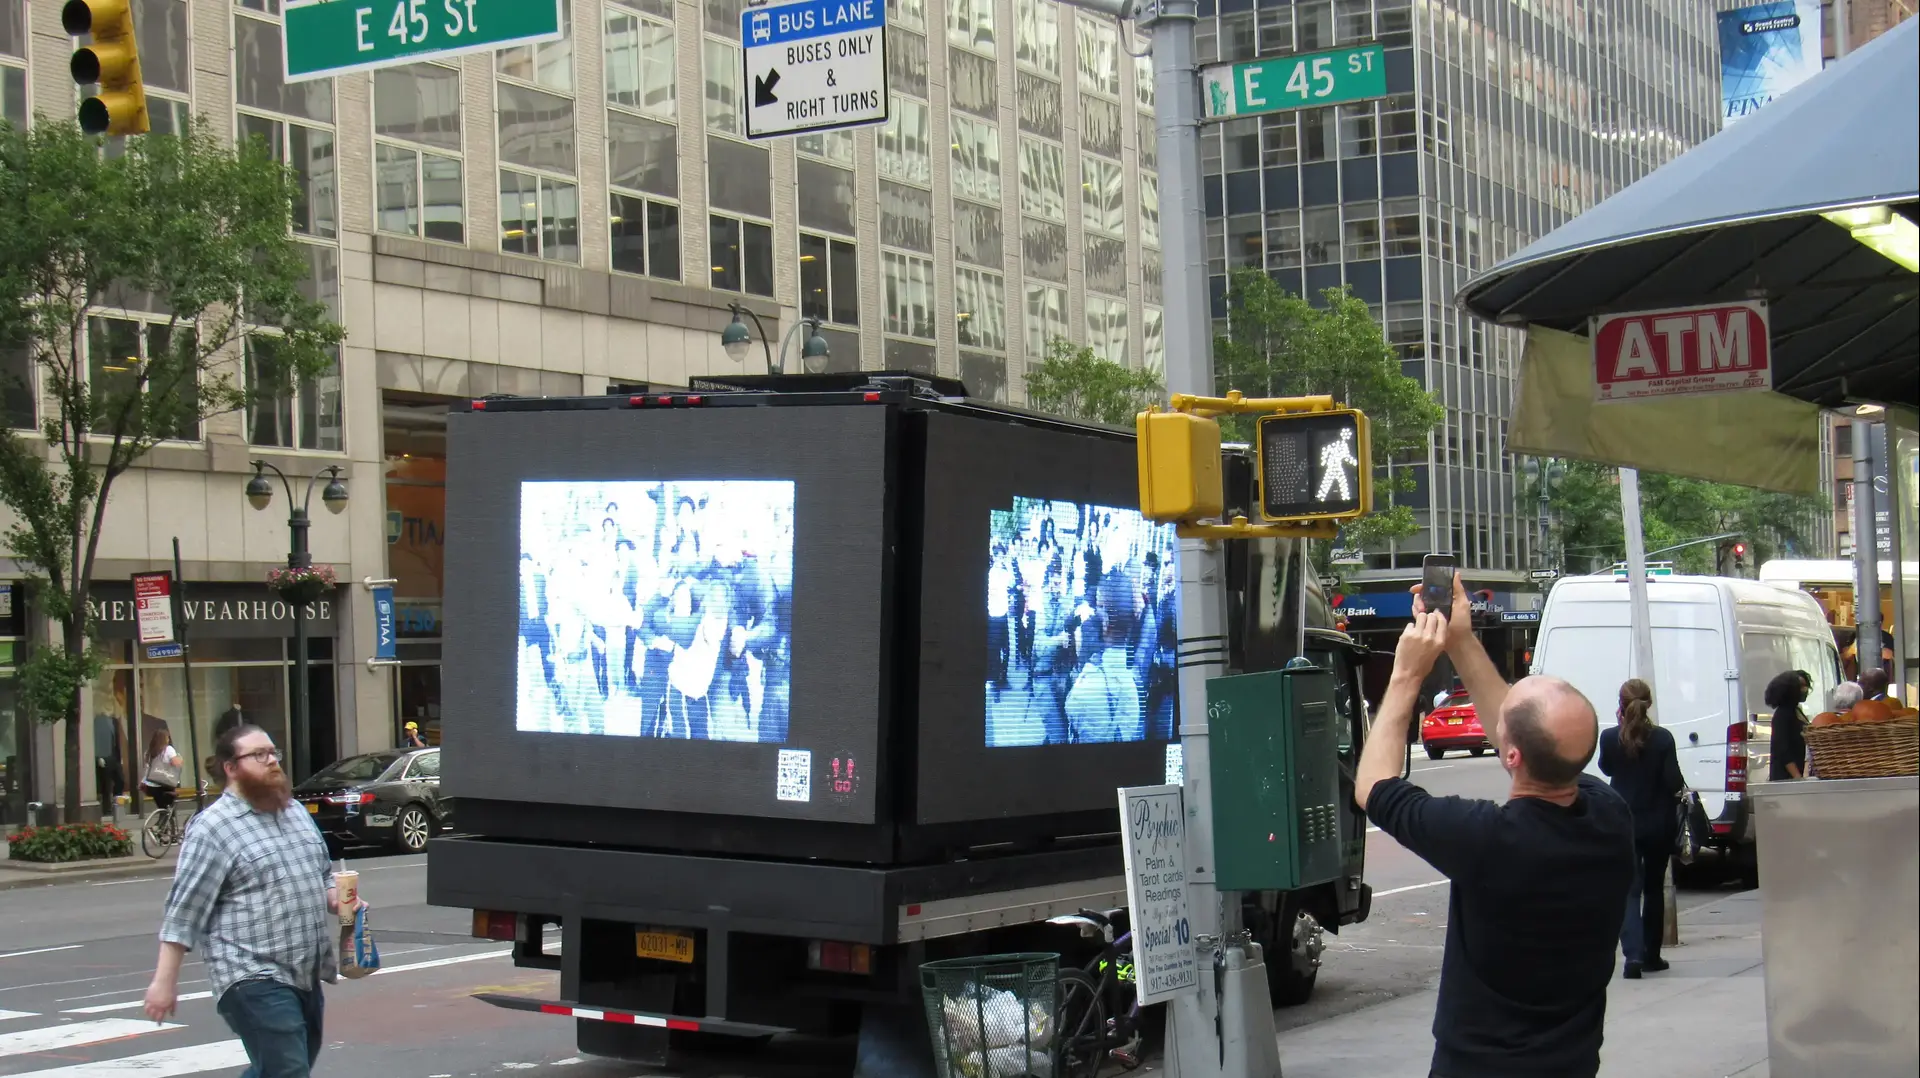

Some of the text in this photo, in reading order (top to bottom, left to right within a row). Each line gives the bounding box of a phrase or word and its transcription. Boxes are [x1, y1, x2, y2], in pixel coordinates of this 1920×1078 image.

[356, 0, 478, 51] E 45 St
[779, 1, 874, 33] BUS LANE
[787, 34, 874, 66] BUSES ONLY
[826, 68, 837, 87] &
[1243, 52, 1375, 106] E 45 ST
[787, 90, 878, 120] RIGHT TURNS
[1613, 309, 1752, 380] ATM
[1665, 377, 1692, 387] Capital
[1693, 376, 1715, 384] Group
[404, 517, 444, 547] TIA
[89, 601, 136, 621] ME
[140, 600, 146, 608] 3
[1348, 606, 1377, 616] Bank
[380, 614, 390, 646] TIAA
[1134, 799, 1179, 855] Psychic
[1145, 855, 1174, 870] Palm &
[1140, 870, 1184, 886] Tarot cards
[1145, 888, 1182, 902] Readings
[1145, 924, 1170, 952] Special
